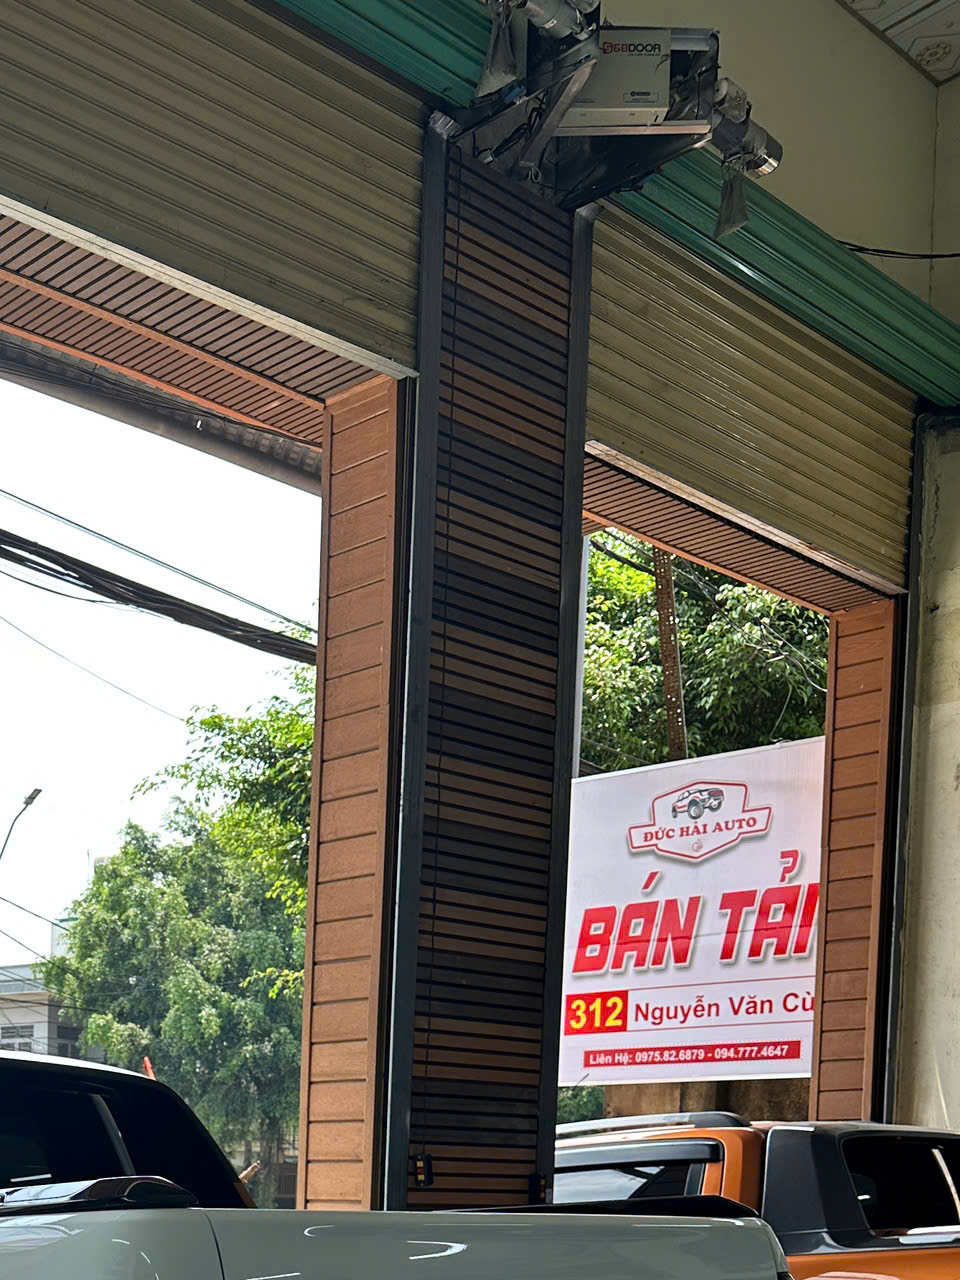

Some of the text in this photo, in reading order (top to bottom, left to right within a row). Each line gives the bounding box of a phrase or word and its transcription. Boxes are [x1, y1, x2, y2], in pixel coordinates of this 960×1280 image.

[643, 817, 757, 842] ĐỨC HẢI AUTO
[572, 849, 820, 973] BÁN TẢI
[569, 996, 624, 1029] 312
[634, 994, 720, 1026] Nguyễn
[729, 996, 773, 1017] Văn
[589, 1053, 613, 1065] Liên
[615, 1051, 633, 1065] Hệ:
[635, 1048, 705, 1063] 0975.82.6879
[714, 1044, 789, 1059] 094.777.4647
